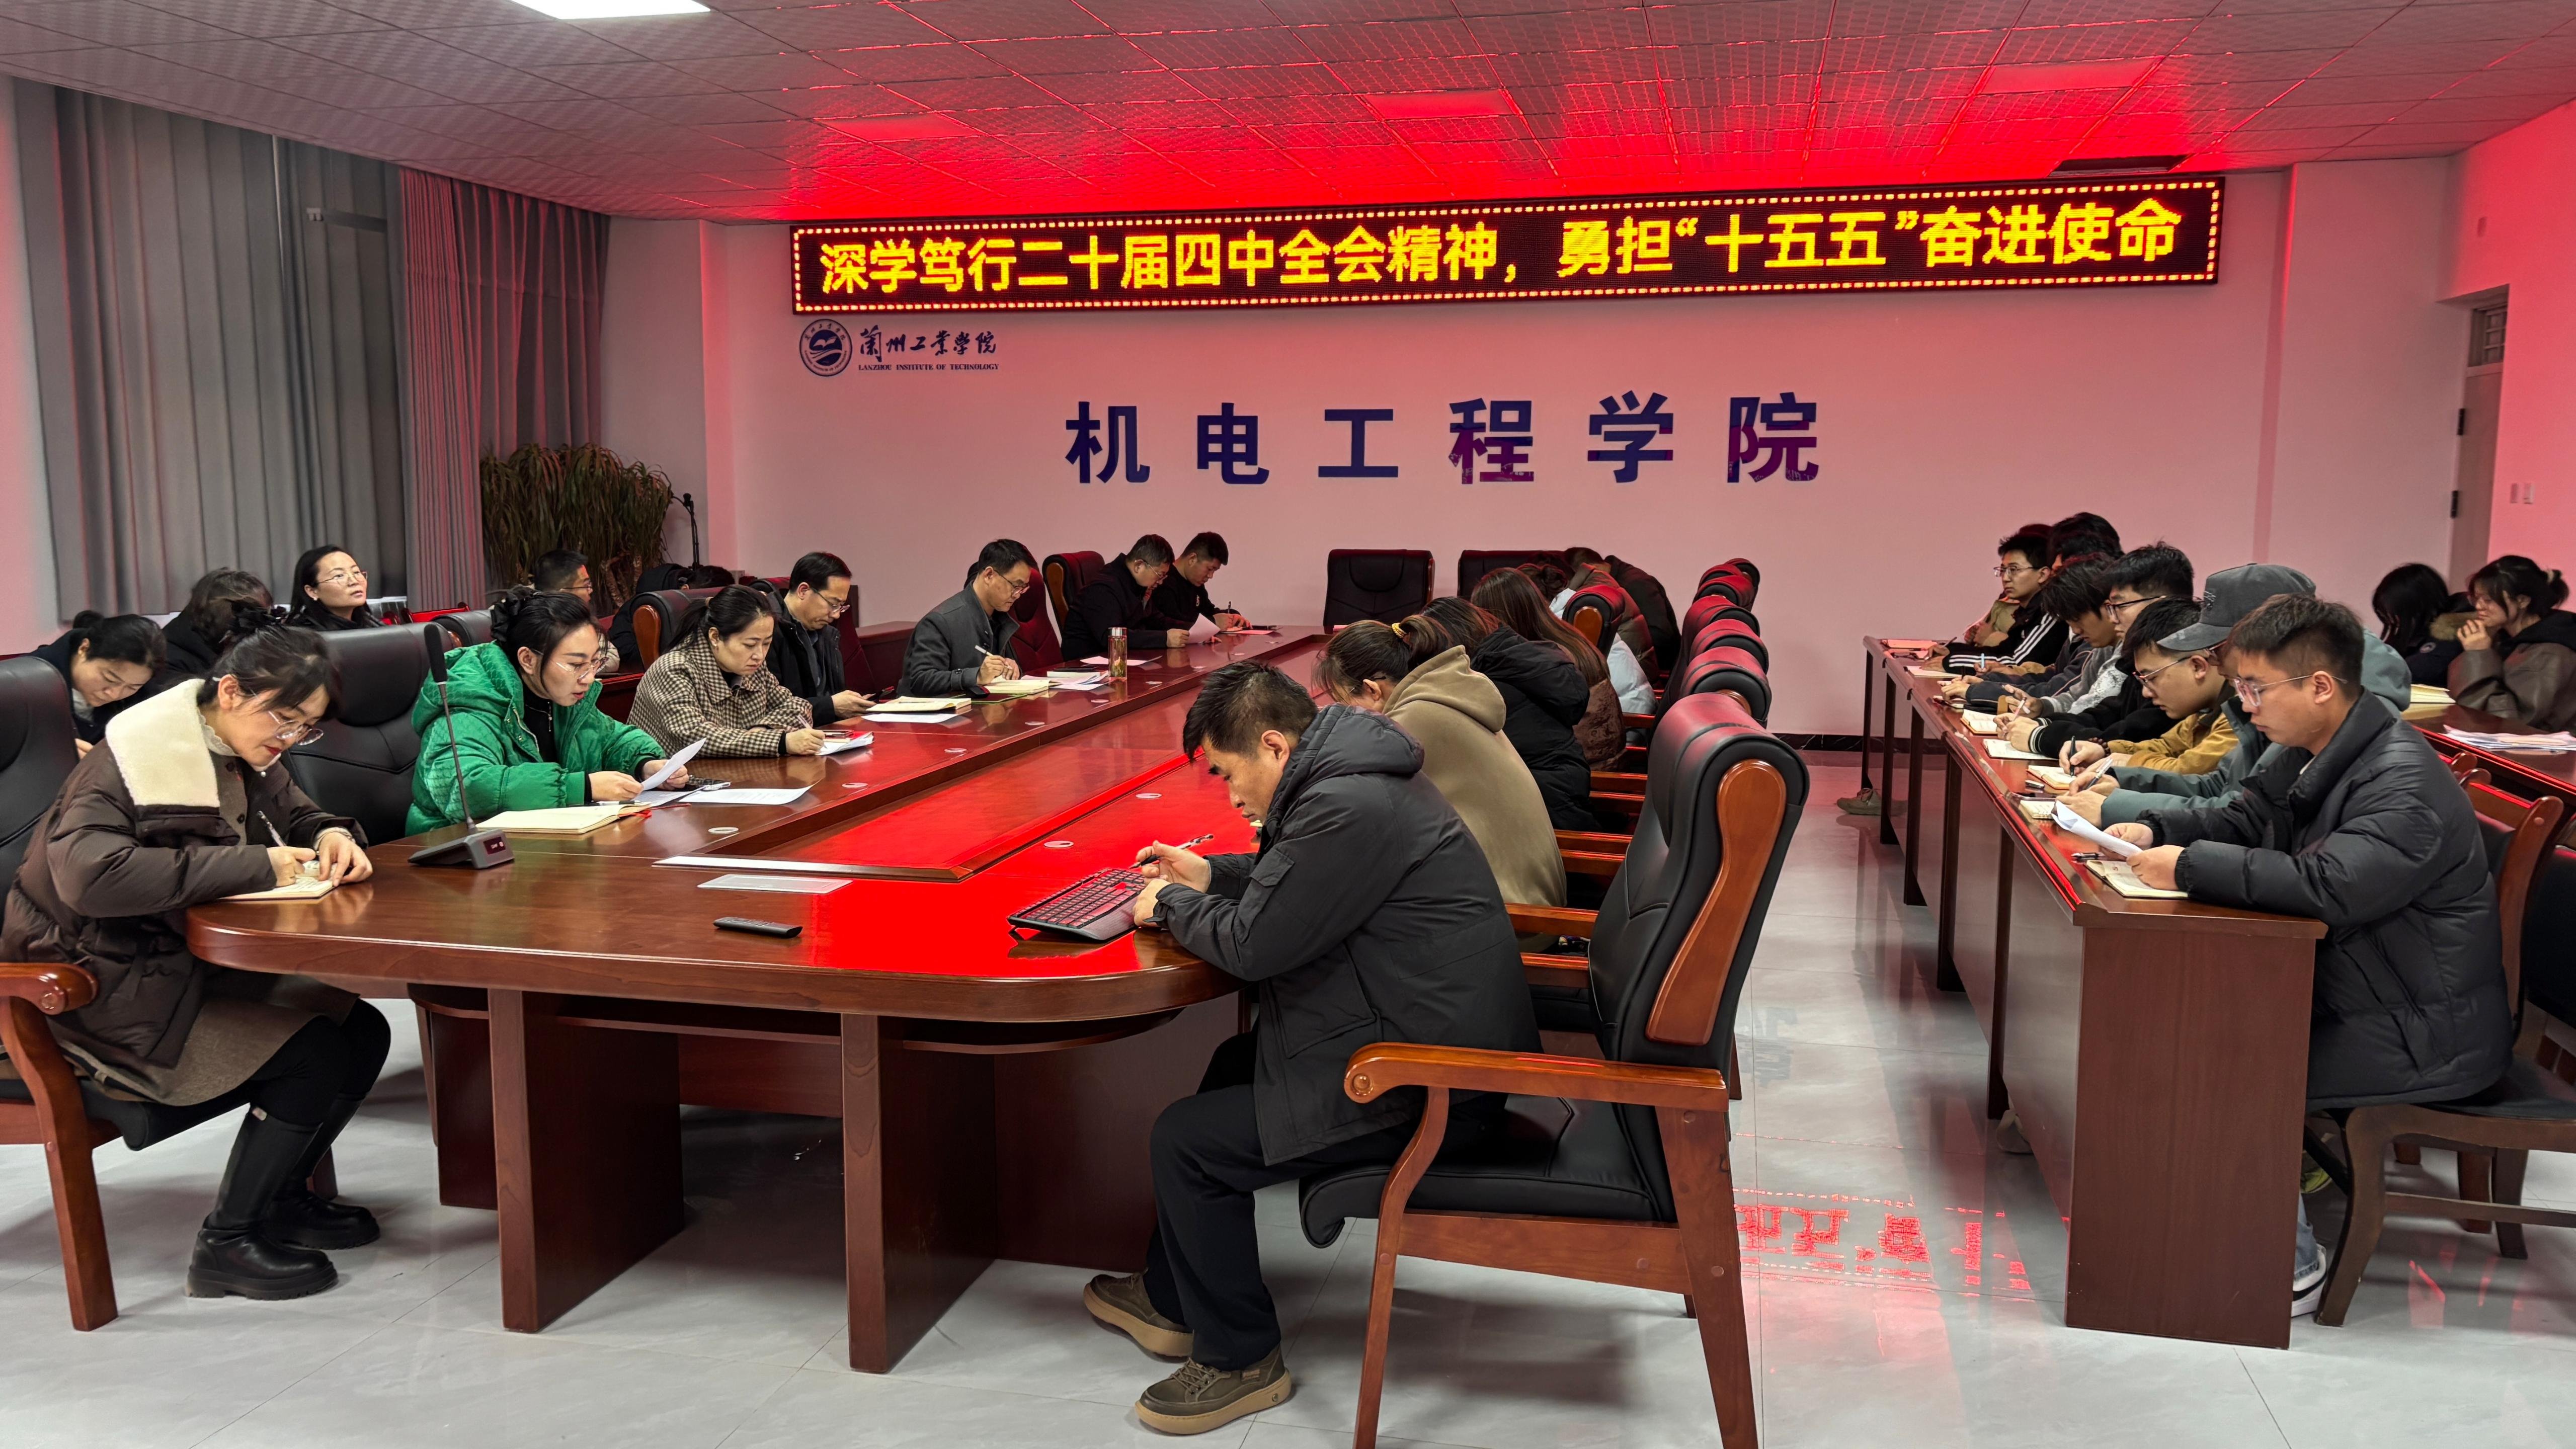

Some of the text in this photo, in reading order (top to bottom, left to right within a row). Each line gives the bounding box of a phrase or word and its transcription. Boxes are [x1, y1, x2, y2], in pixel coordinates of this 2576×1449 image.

[820, 198, 2182, 294] 深学笃行二十届四中全会精神，勇担“十五五”奋进使命
[1065, 390, 1819, 485] 机电工程学院
